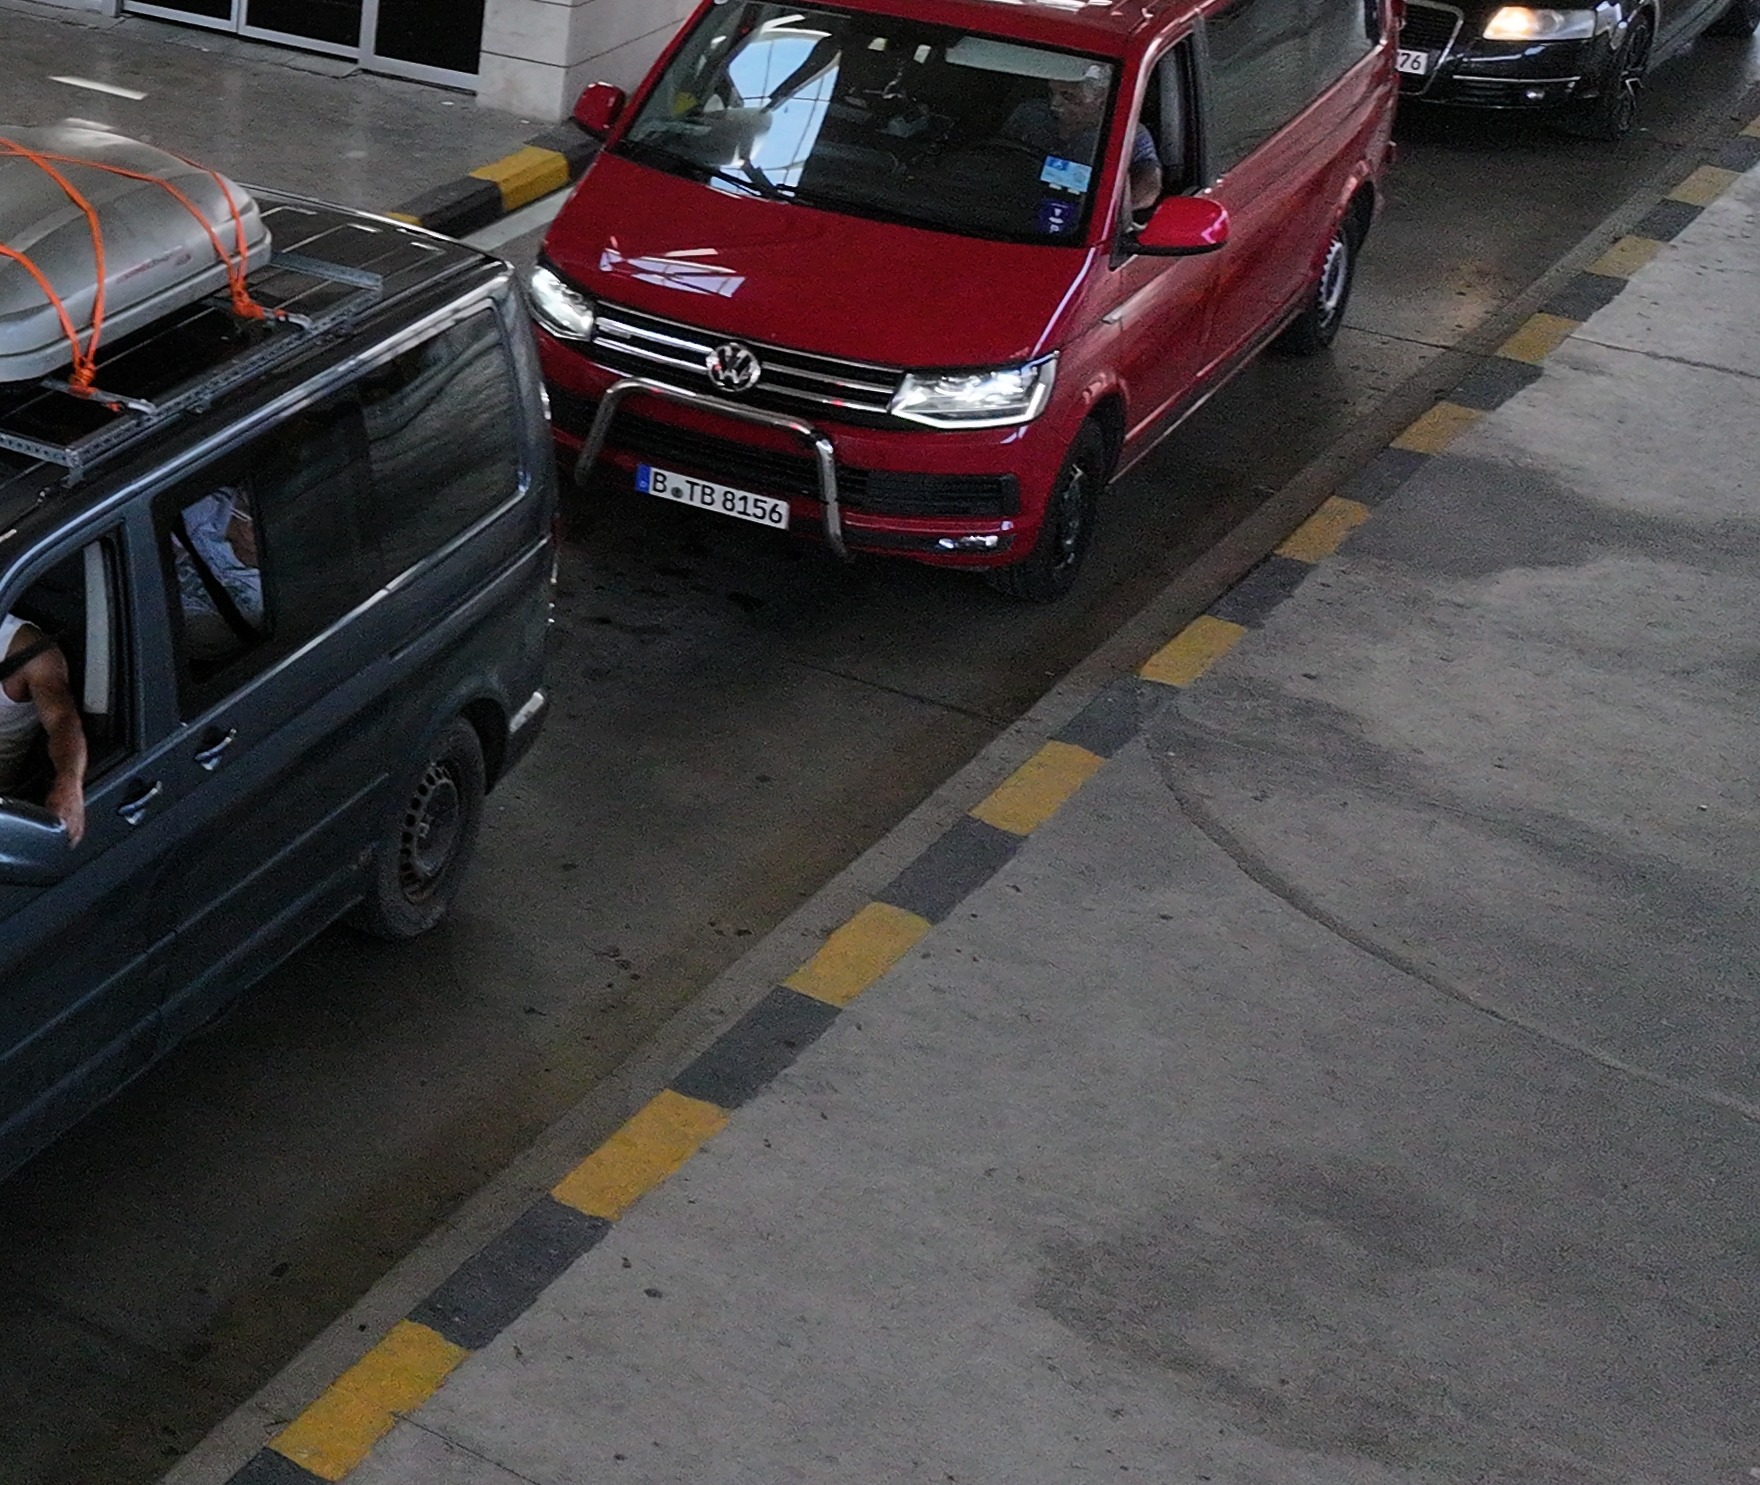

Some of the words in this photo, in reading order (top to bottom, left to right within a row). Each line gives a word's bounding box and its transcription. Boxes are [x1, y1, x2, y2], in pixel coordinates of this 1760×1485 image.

[1400, 52, 1421, 71] 76
[652, 471, 668, 493] B
[685, 480, 716, 507] TB
[722, 489, 785, 525] 8156
